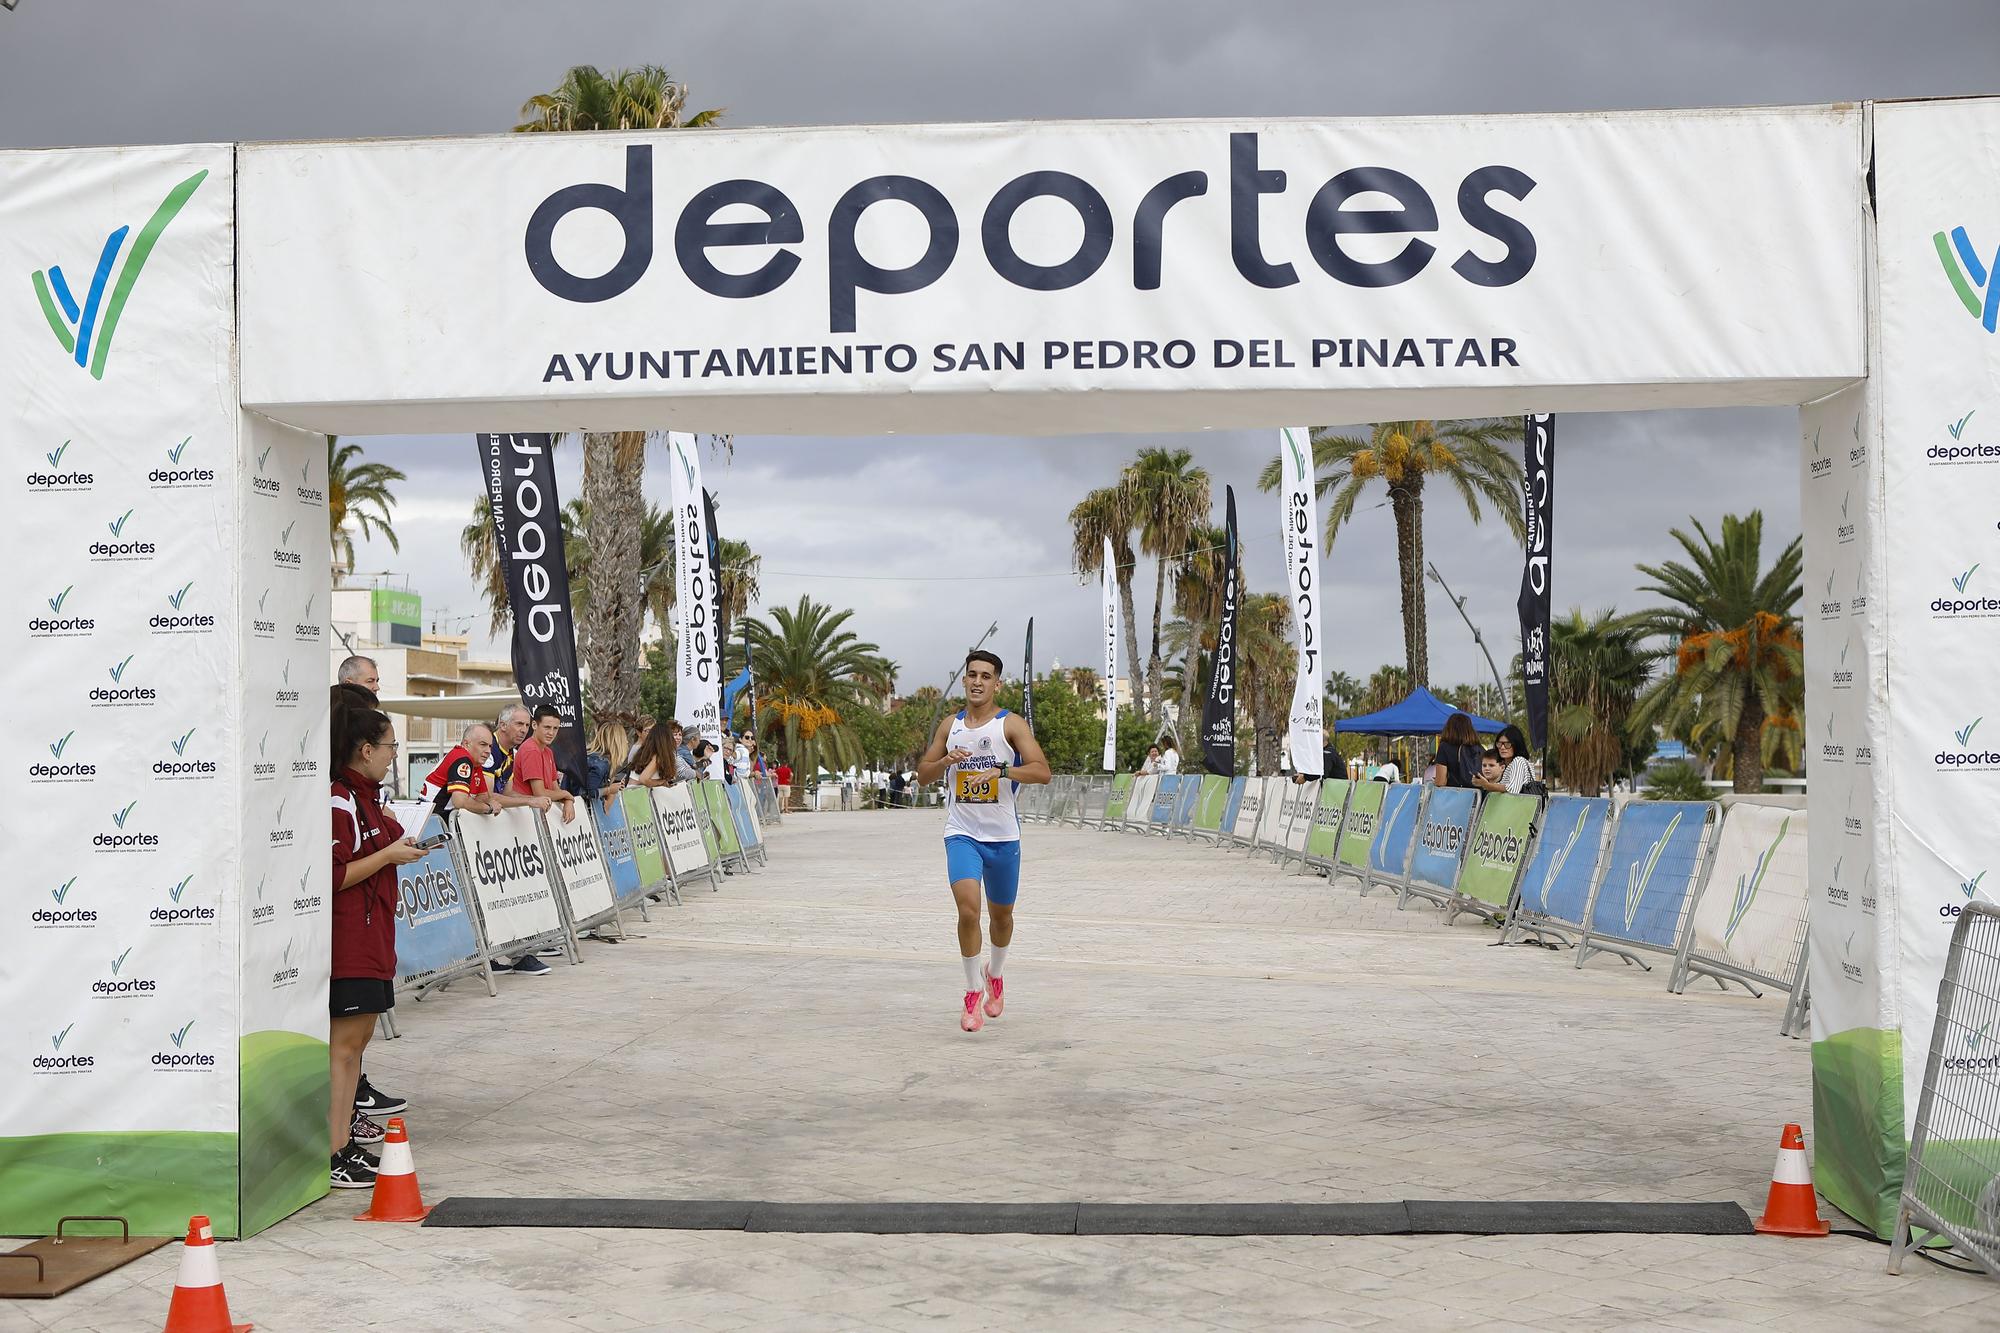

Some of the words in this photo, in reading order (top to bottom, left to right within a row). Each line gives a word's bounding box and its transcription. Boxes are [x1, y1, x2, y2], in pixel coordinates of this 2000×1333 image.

[525, 132, 1537, 333] deportes
[542, 344, 918, 382] AYUNTAMIENTO
[933, 341, 1024, 372] SAN
[1044, 340, 1196, 370] PEDRO
[1213, 339, 1295, 368] DEL
[1312, 337, 1520, 368] PINATAR
[1927, 443, 2000, 460] deportes
[27, 472, 93, 487] deportes
[149, 468, 214, 484] deportes
[89, 541, 155, 557] deportes
[1931, 597, 2000, 614] deporte
[29, 617, 95, 633] deportes
[149, 613, 214, 629] deportes
[89, 686, 156, 702] deportes
[30, 762, 96, 778] deportes
[153, 760, 216, 776] deportes
[962, 781, 990, 795] 309
[93, 832, 158, 848] deportes
[556, 825, 597, 875] deportes
[475, 837, 544, 893] deportes
[394, 862, 459, 929] portes
[32, 908, 97, 924] deportes
[150, 906, 215, 922] deportes
[92, 978, 155, 995] deportes
[33, 1055, 94, 1070] deportes
[151, 1052, 214, 1067] deportes
